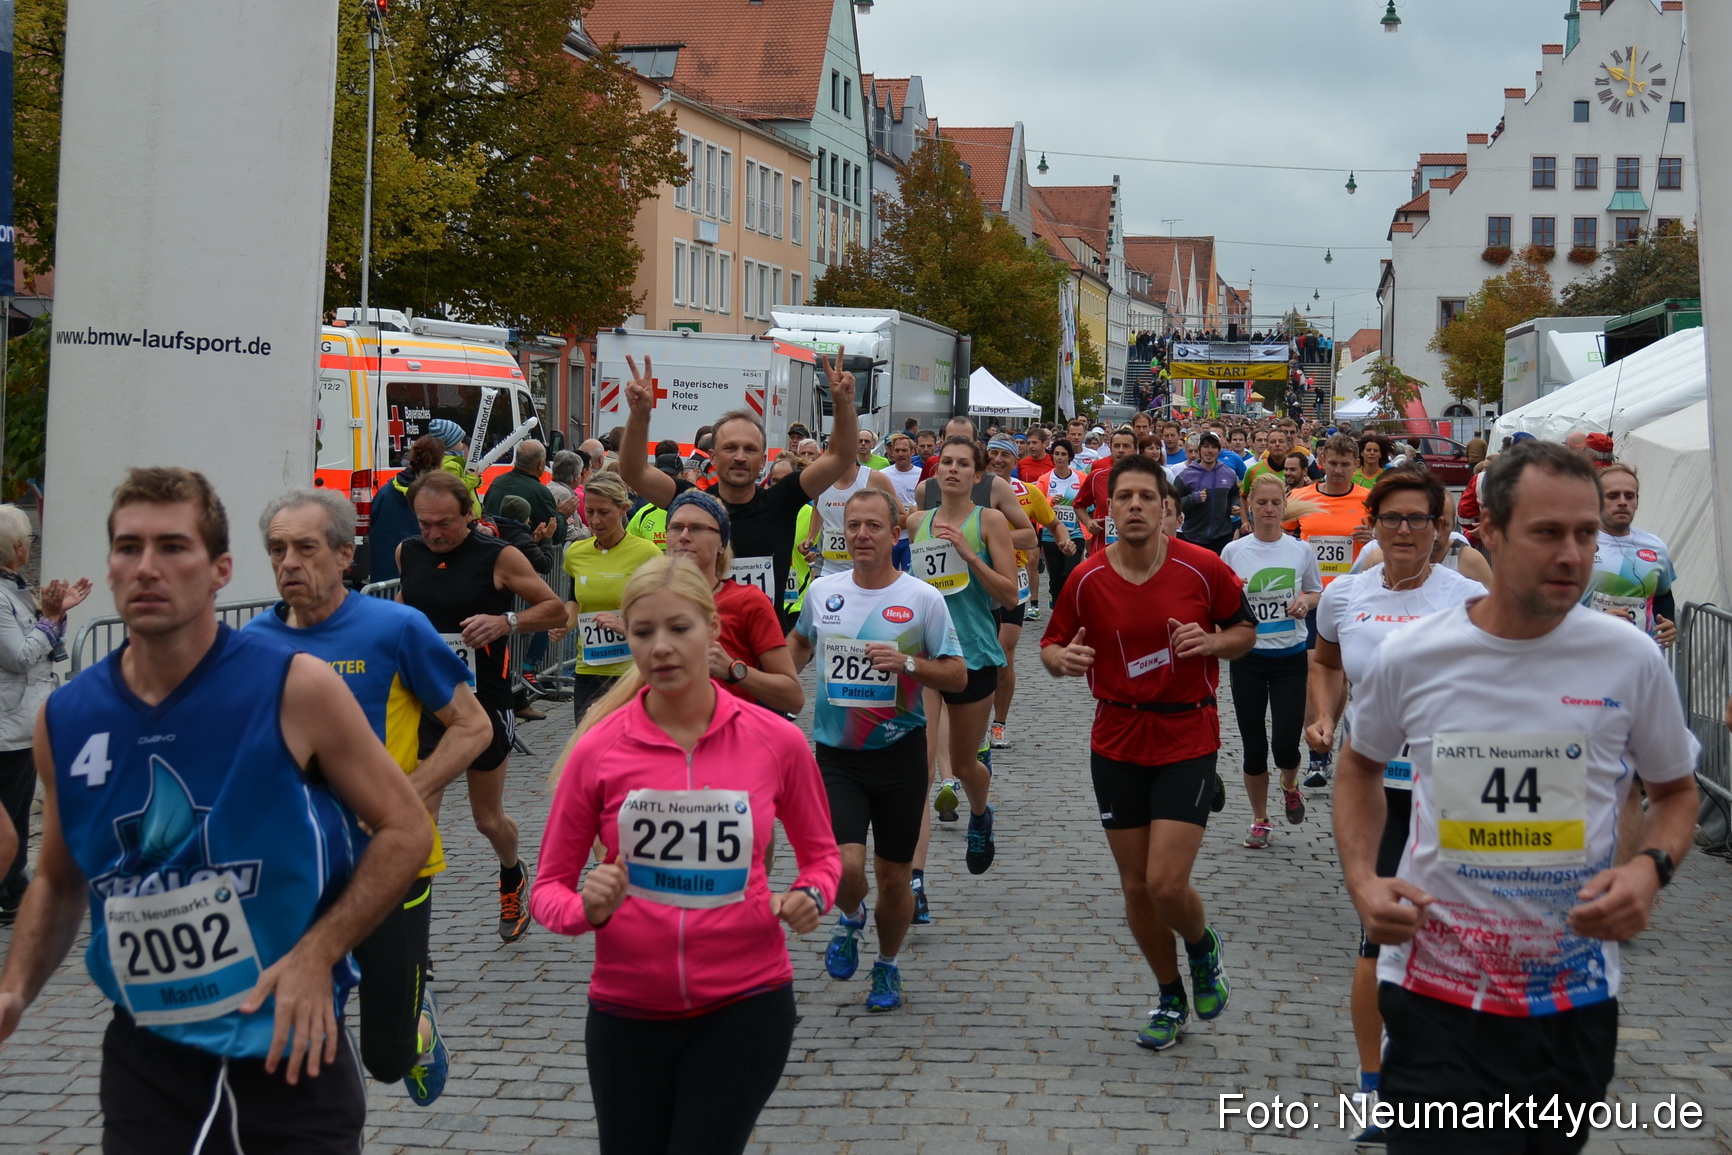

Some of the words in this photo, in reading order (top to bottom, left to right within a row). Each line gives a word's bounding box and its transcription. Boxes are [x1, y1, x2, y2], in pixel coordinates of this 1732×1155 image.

[56, 326, 272, 356] www.bmw-laufsport.de
[1208, 367, 1248, 376] START
[673, 379, 729, 390] Bayerisches
[672, 391, 698, 400] Rotes
[404, 406, 431, 421] Bayerisches
[672, 402, 698, 411] Kreuz
[972, 406, 1010, 414] Laufsport
[926, 543, 953, 551] Neumarkt
[1317, 546, 1344, 561] 236
[925, 552, 946, 576] 37
[591, 648, 624, 657] Alexandra
[1139, 657, 1159, 670] DEHN
[842, 687, 875, 698] Patrick
[1561, 696, 1621, 708] CeramTec
[70, 732, 112, 787] 4
[1437, 747, 1485, 759] PARTL
[1489, 747, 1560, 759] Neumarkt
[1481, 767, 1541, 813] 44
[624, 800, 665, 813] PARTL
[669, 802, 730, 813] Neumarkt
[633, 818, 740, 862] 2215
[1469, 828, 1552, 847] Matthias
[655, 872, 714, 891] Natalie
[108, 910, 140, 923] PARTL
[141, 896, 210, 921] Neumarkt
[119, 912, 239, 978] 2092
[160, 981, 220, 1006] Martin
